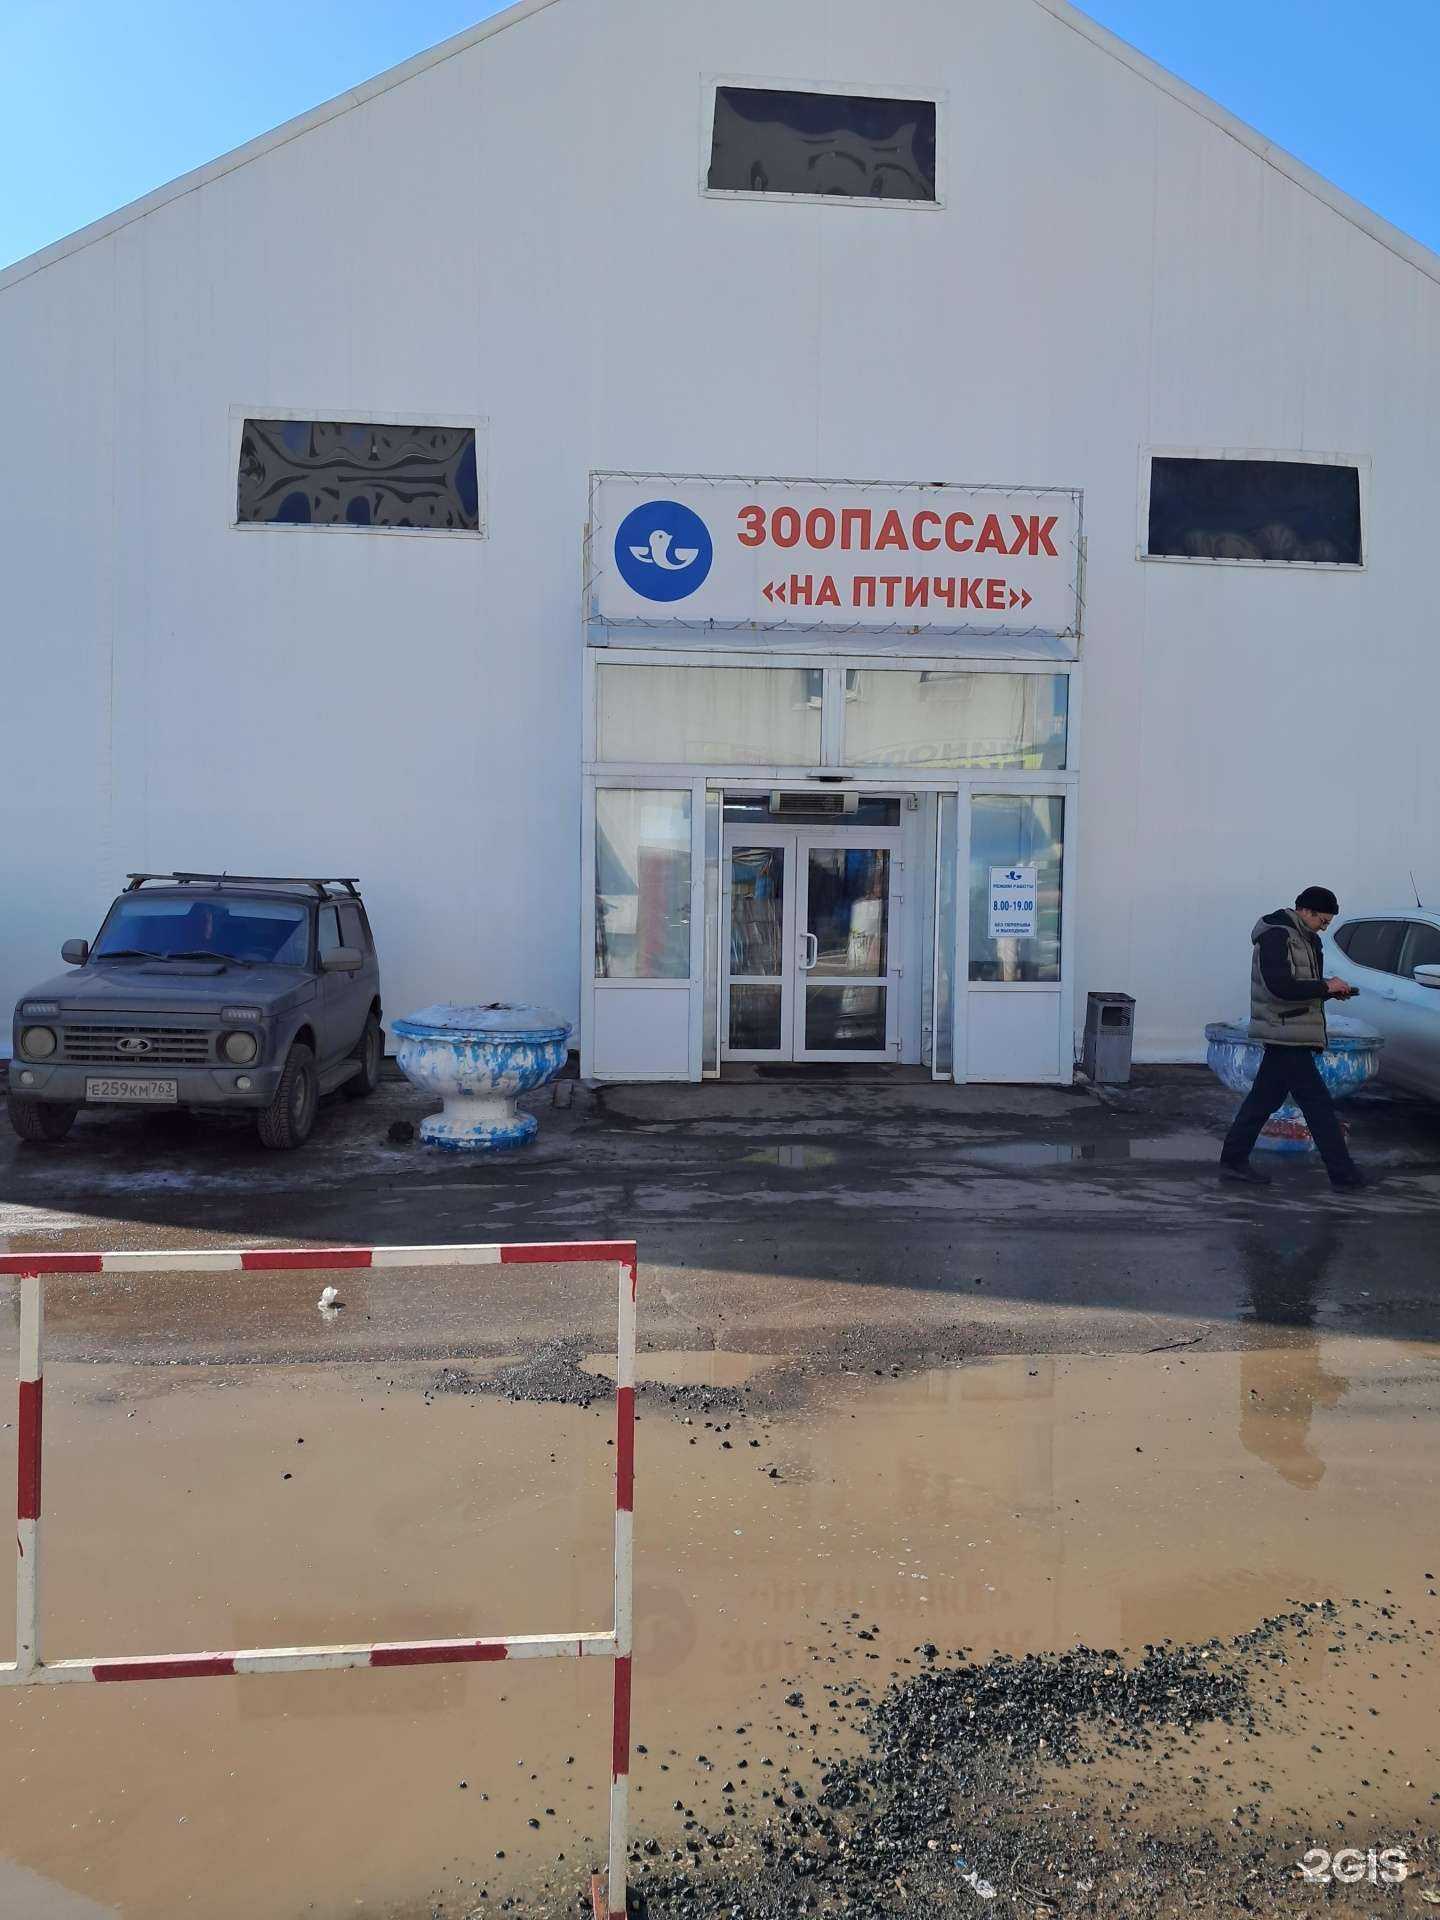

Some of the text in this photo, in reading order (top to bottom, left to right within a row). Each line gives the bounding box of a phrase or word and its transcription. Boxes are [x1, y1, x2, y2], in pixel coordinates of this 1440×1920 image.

[737, 505, 1059, 556] ЗООПАССАЖ
[762, 574, 1033, 610] «НА ПТИЧКЕ»
[993, 900, 1033, 911] 8.00-19.00
